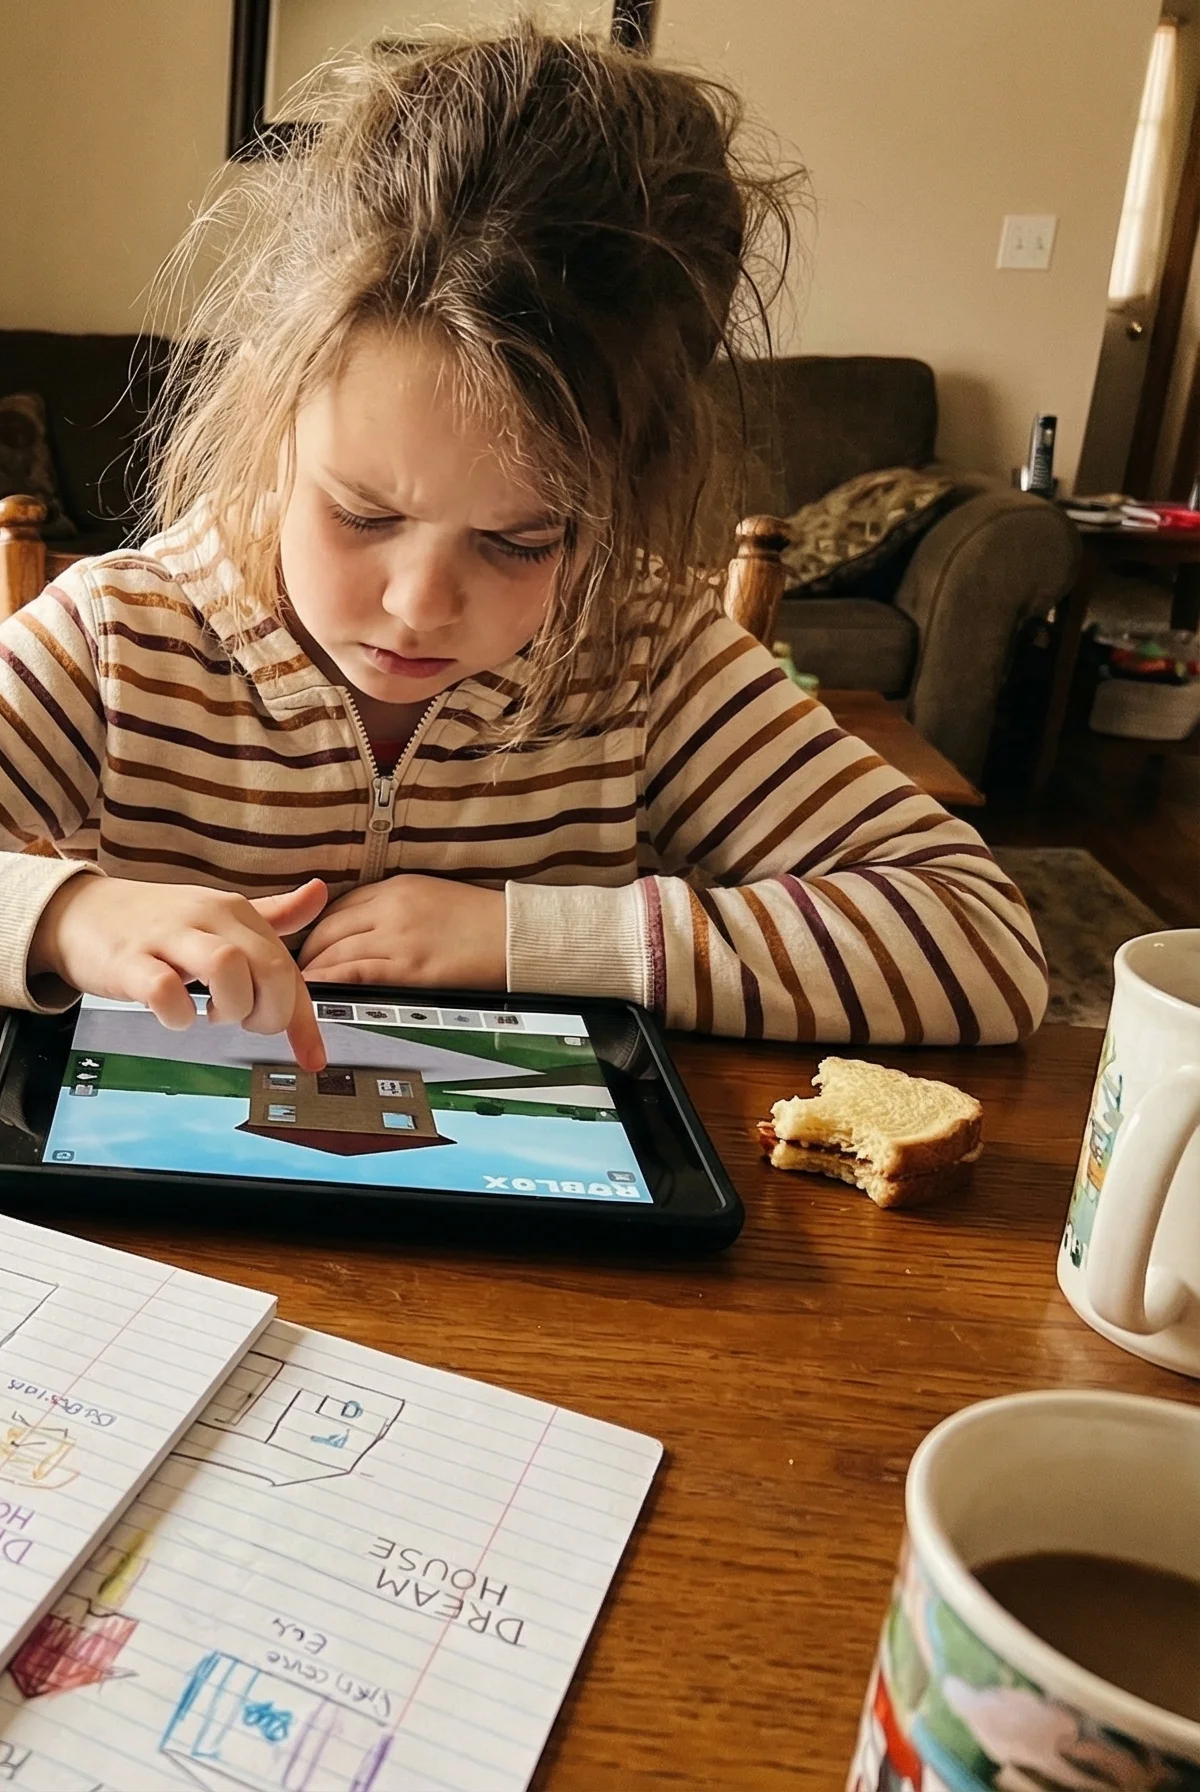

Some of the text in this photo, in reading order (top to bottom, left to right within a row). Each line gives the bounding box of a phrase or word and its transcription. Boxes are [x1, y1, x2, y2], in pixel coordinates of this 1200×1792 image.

[483, 1175, 641, 1199] ROBLOX
[367, 1537, 508, 1606] HOUSE
[376, 1568, 527, 1648] DREAM
